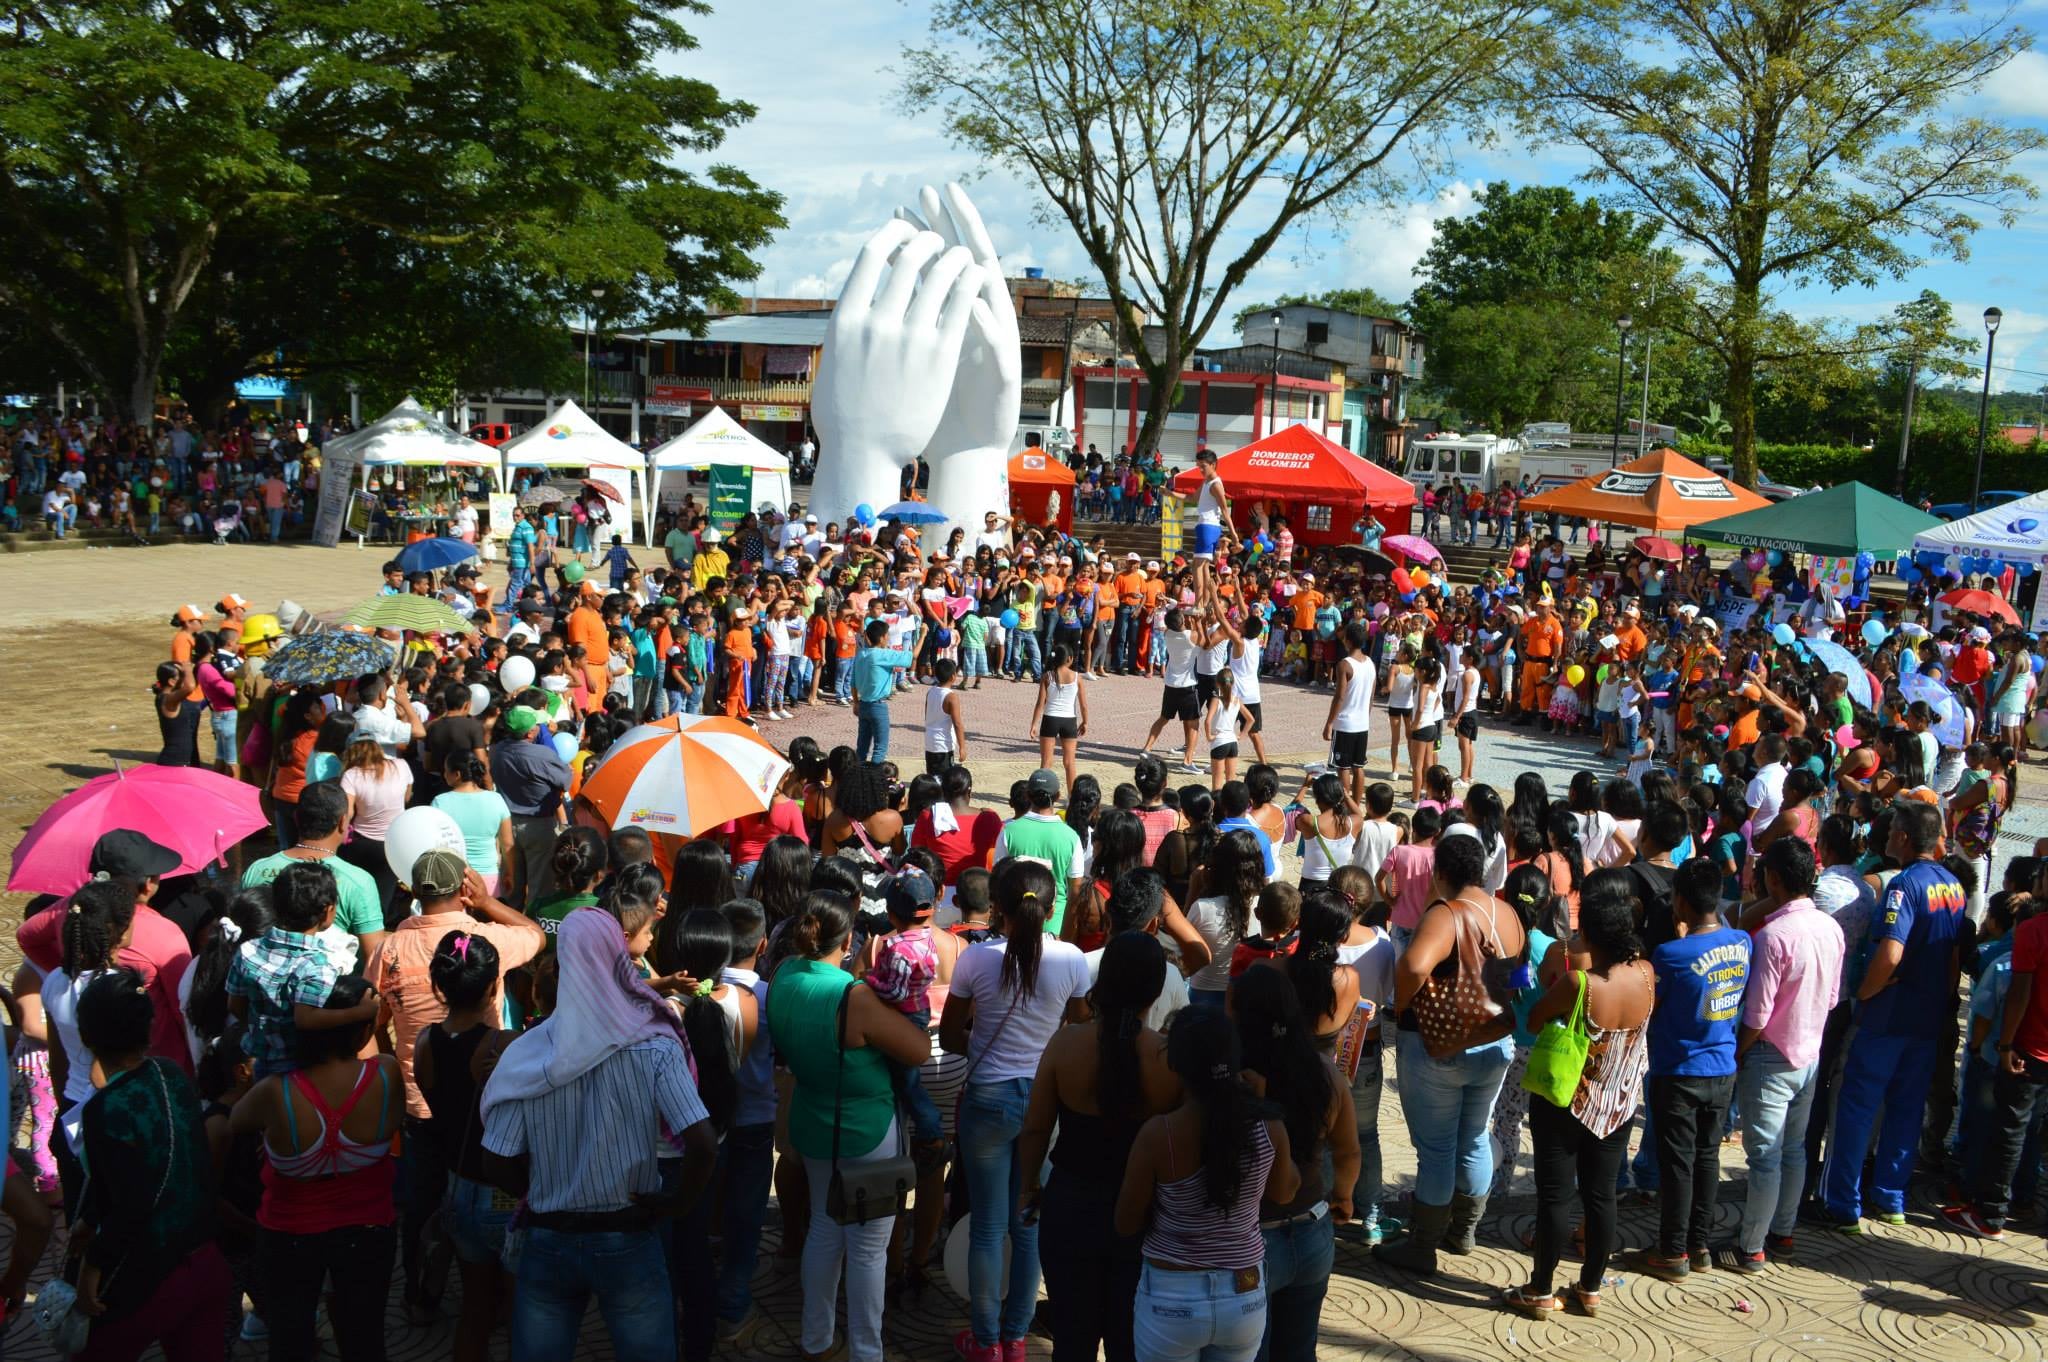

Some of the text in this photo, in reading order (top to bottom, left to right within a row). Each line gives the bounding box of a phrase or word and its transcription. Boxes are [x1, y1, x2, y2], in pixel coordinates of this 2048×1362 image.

[1247, 459, 1310, 469] COLOMBIA
[1251, 450, 1315, 460] BOMBEROS
[1723, 532, 1808, 553] POLICIA NACIONAL
[1690, 943, 1749, 977] CALIFORNIA
[1707, 964, 1745, 985] STRONG
